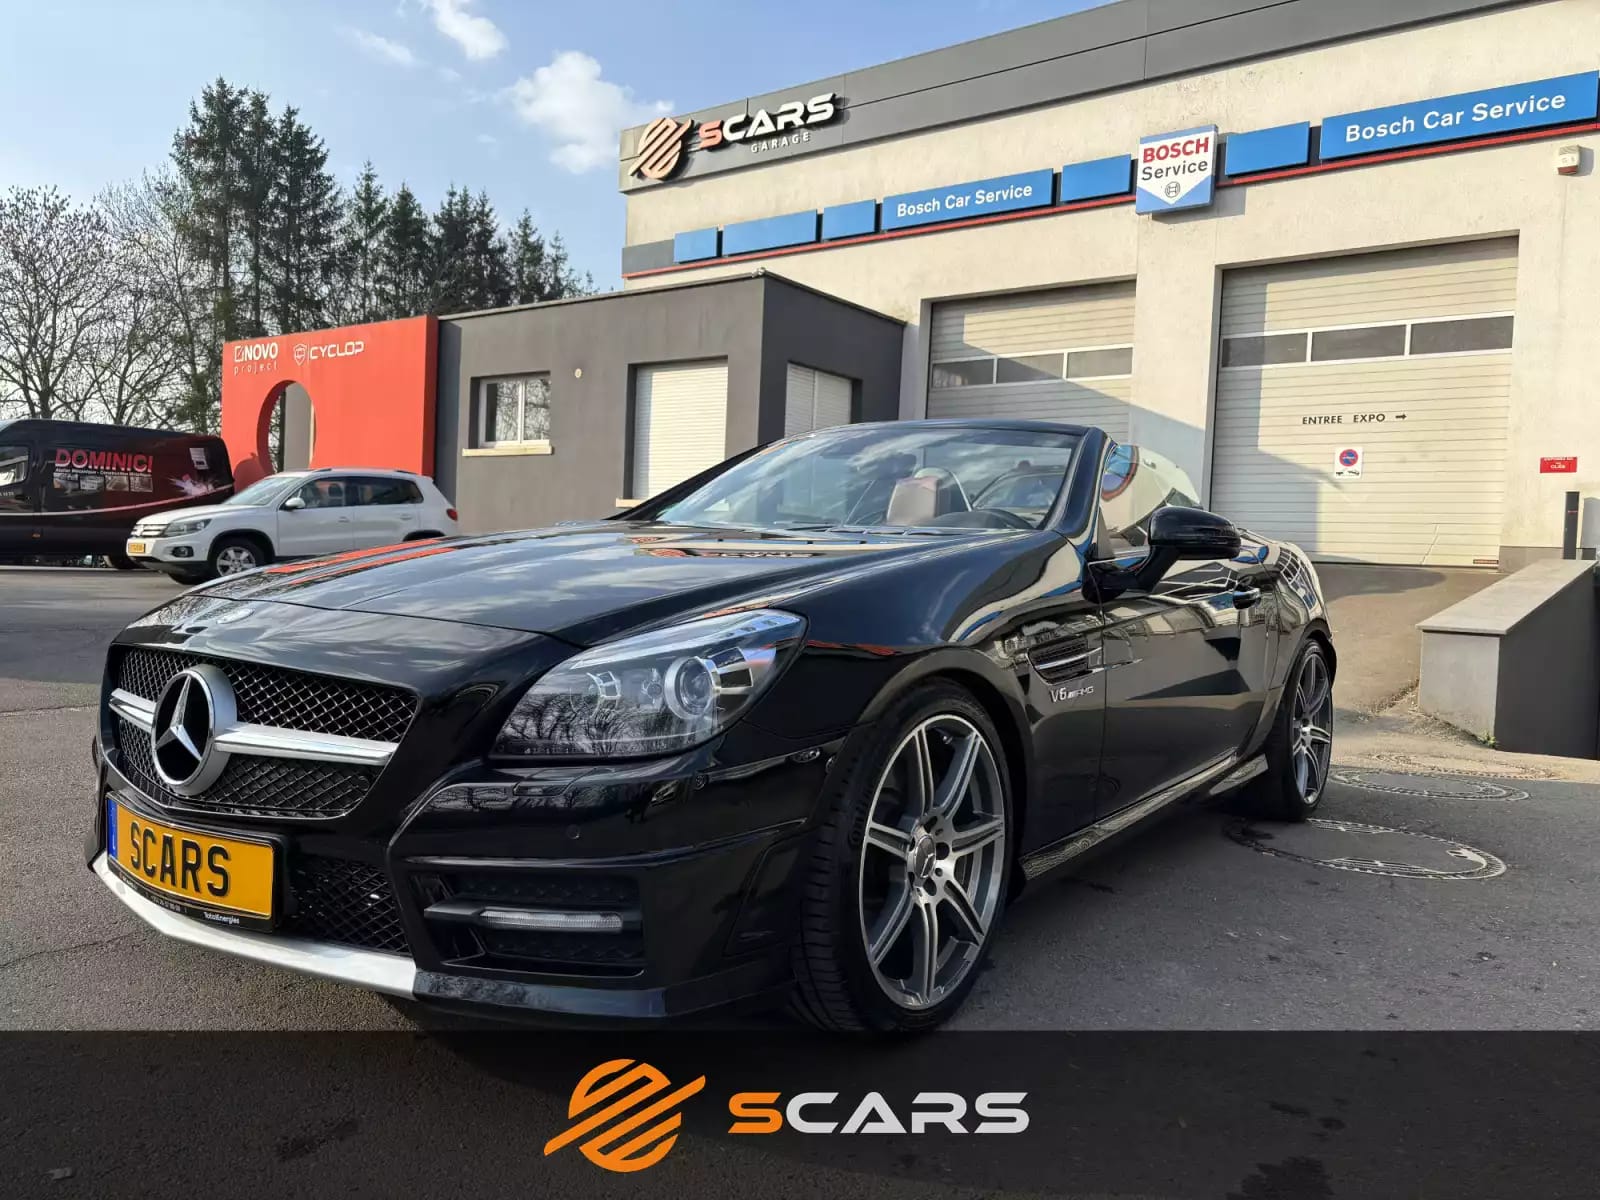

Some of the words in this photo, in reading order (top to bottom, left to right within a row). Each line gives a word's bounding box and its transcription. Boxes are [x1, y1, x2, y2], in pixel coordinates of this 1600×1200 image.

[699, 93, 834, 150] SCARS
[1345, 116, 1415, 143] Bosch
[1423, 110, 1465, 129] Car
[1471, 94, 1566, 122] Service
[751, 131, 809, 153] GARAGE
[1143, 137, 1209, 164] BOSCH
[1141, 160, 1208, 181] Service
[897, 198, 940, 217] Bosch
[945, 195, 971, 209] Car
[975, 185, 1033, 204] Service
[309, 341, 364, 360] CYCLOP
[234, 361, 277, 375] project
[1302, 415, 1343, 425] ENTREE
[1353, 413, 1385, 423] EXPO
[55, 448, 153, 473] DOMINICI
[1050, 687, 1067, 703] V6
[131, 821, 230, 897] SCARS
[203, 911, 240, 925] TotalEnergies
